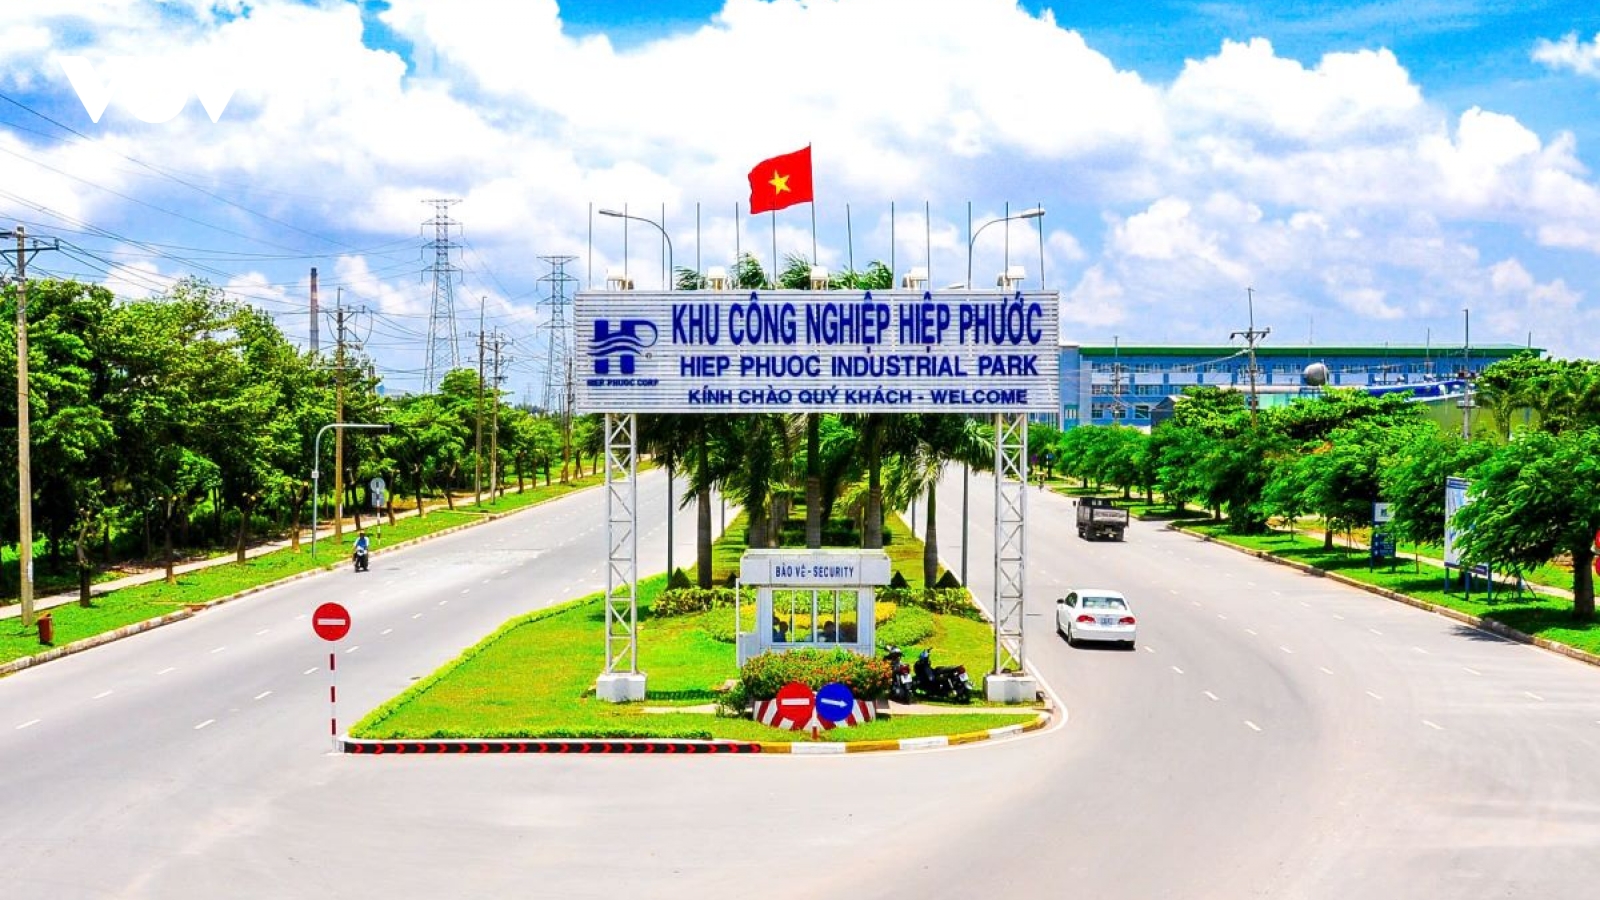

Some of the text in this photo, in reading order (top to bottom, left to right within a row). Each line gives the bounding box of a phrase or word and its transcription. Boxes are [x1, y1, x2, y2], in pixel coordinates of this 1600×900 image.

[672, 291, 1042, 353] KHU CÔNG NGHIỆP HIỆP PHƯỚC
[680, 355, 1038, 377] HIEP PHUOC INDUSTRIAL PARK
[688, 385, 733, 405] KÍNH
[738, 385, 793, 405] CHÀO
[798, 385, 839, 405] QUÝ
[845, 385, 912, 405] KHÁCH
[930, 389, 1028, 405] WELCOME
[812, 566, 854, 578] SECURITY
